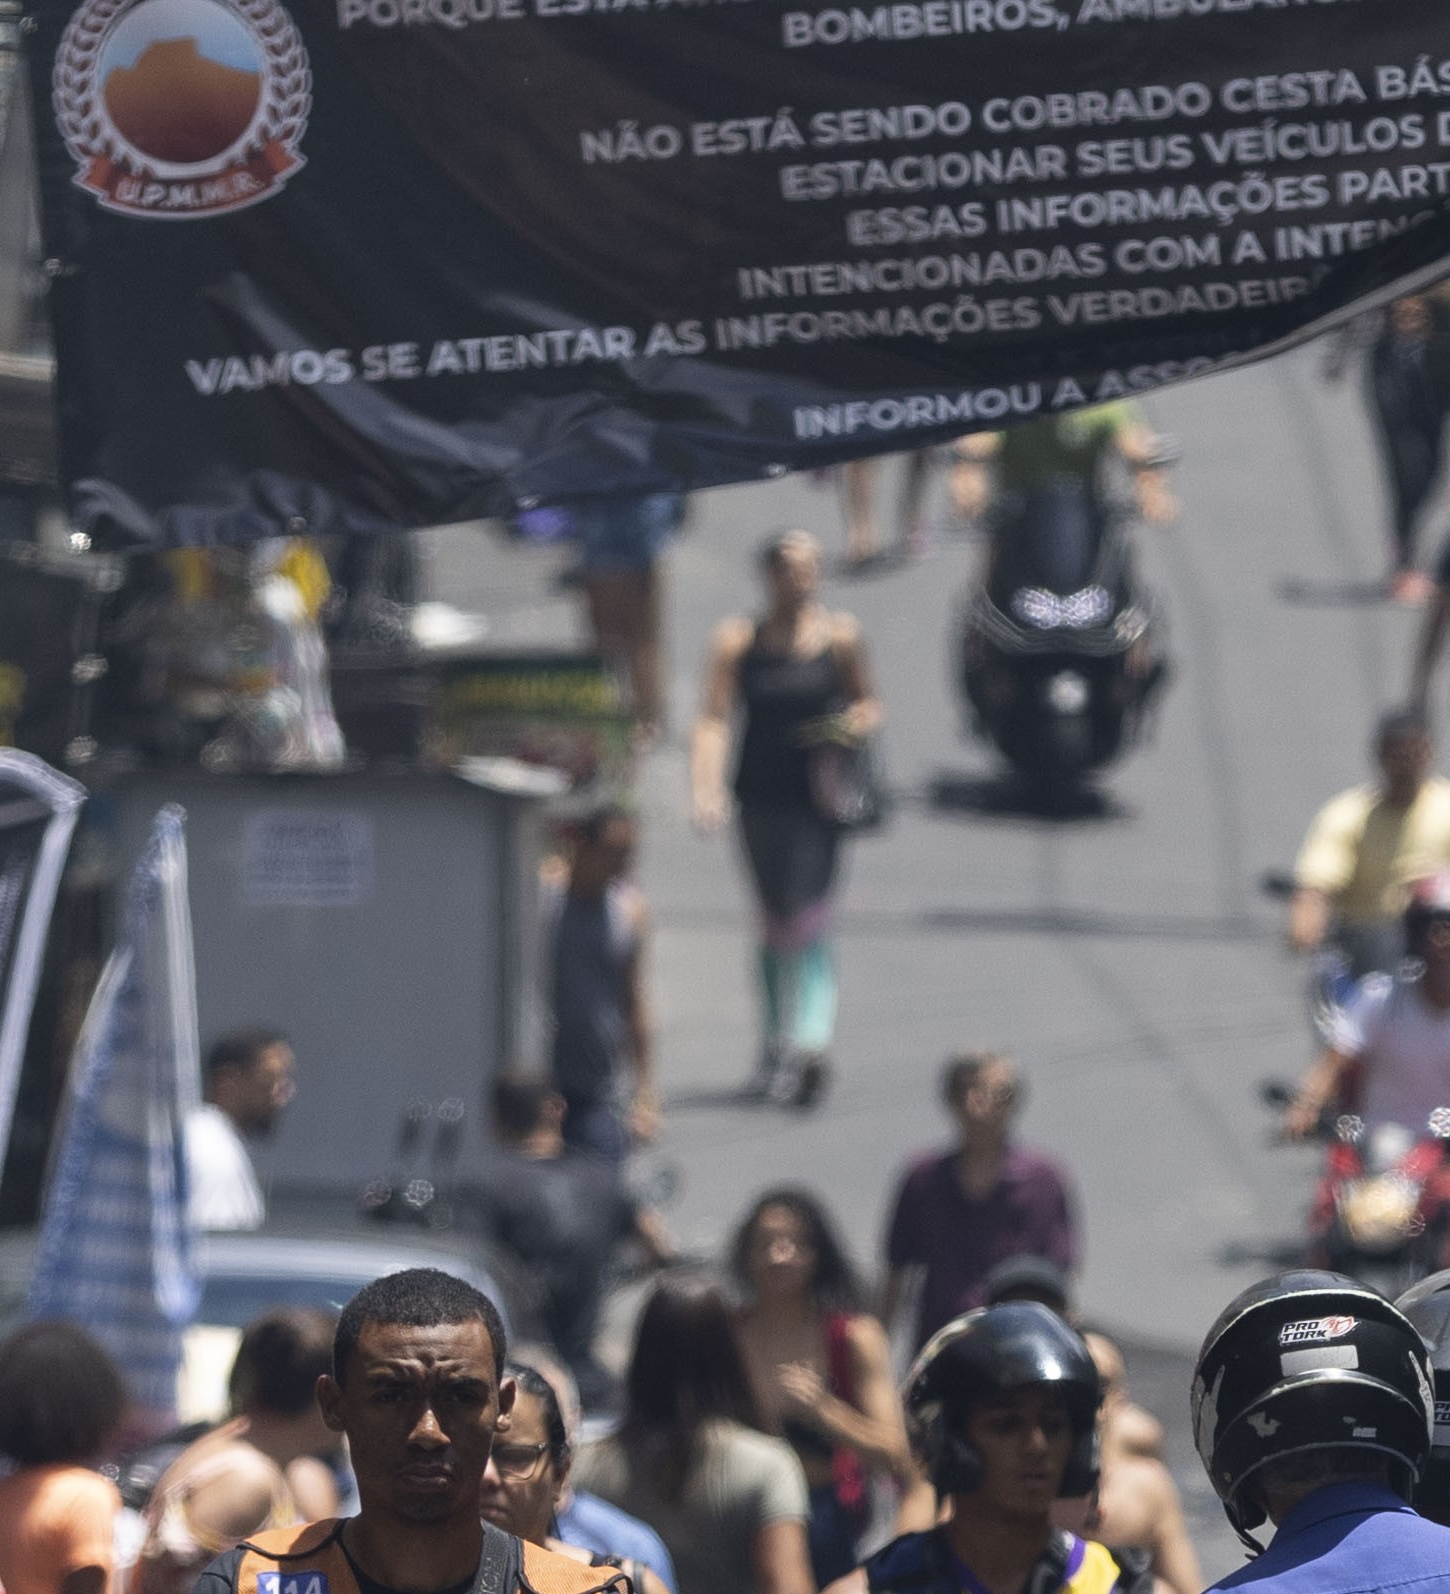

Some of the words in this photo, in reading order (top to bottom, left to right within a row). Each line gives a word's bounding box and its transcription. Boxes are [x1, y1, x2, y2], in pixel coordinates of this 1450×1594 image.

[782, 0, 1070, 48] BOMBEIROS,
[580, 119, 681, 163] NÃO
[690, 107, 806, 157] ESTÁ
[809, 101, 972, 146] SENDO
[981, 81, 1211, 132] COBRADO
[1221, 68, 1367, 112] CESTA
[779, 141, 1067, 201] ESTACIONAR
[1076, 134, 1195, 179] SEUS
[1200, 111, 1426, 165] VEÍCULOS
[848, 202, 988, 246] ESSAS
[997, 171, 1329, 233] INFORMAÇÕES
[736, 242, 1107, 299] INTENCIONADAS
[1113, 235, 1220, 274] COM
[1233, 232, 1267, 265] A
[185, 348, 356, 395] VAMOS
[361, 341, 421, 383] SE
[426, 326, 637, 377] ATENTAR
[645, 320, 706, 357] AS
[714, 295, 1043, 351] INFORMAÇÕES
[793, 381, 1043, 439] INFORMOU
[1050, 377, 1087, 406] A
[1281, 1330, 1327, 1342] TORK
[1284, 1321, 1320, 1332] PRO
